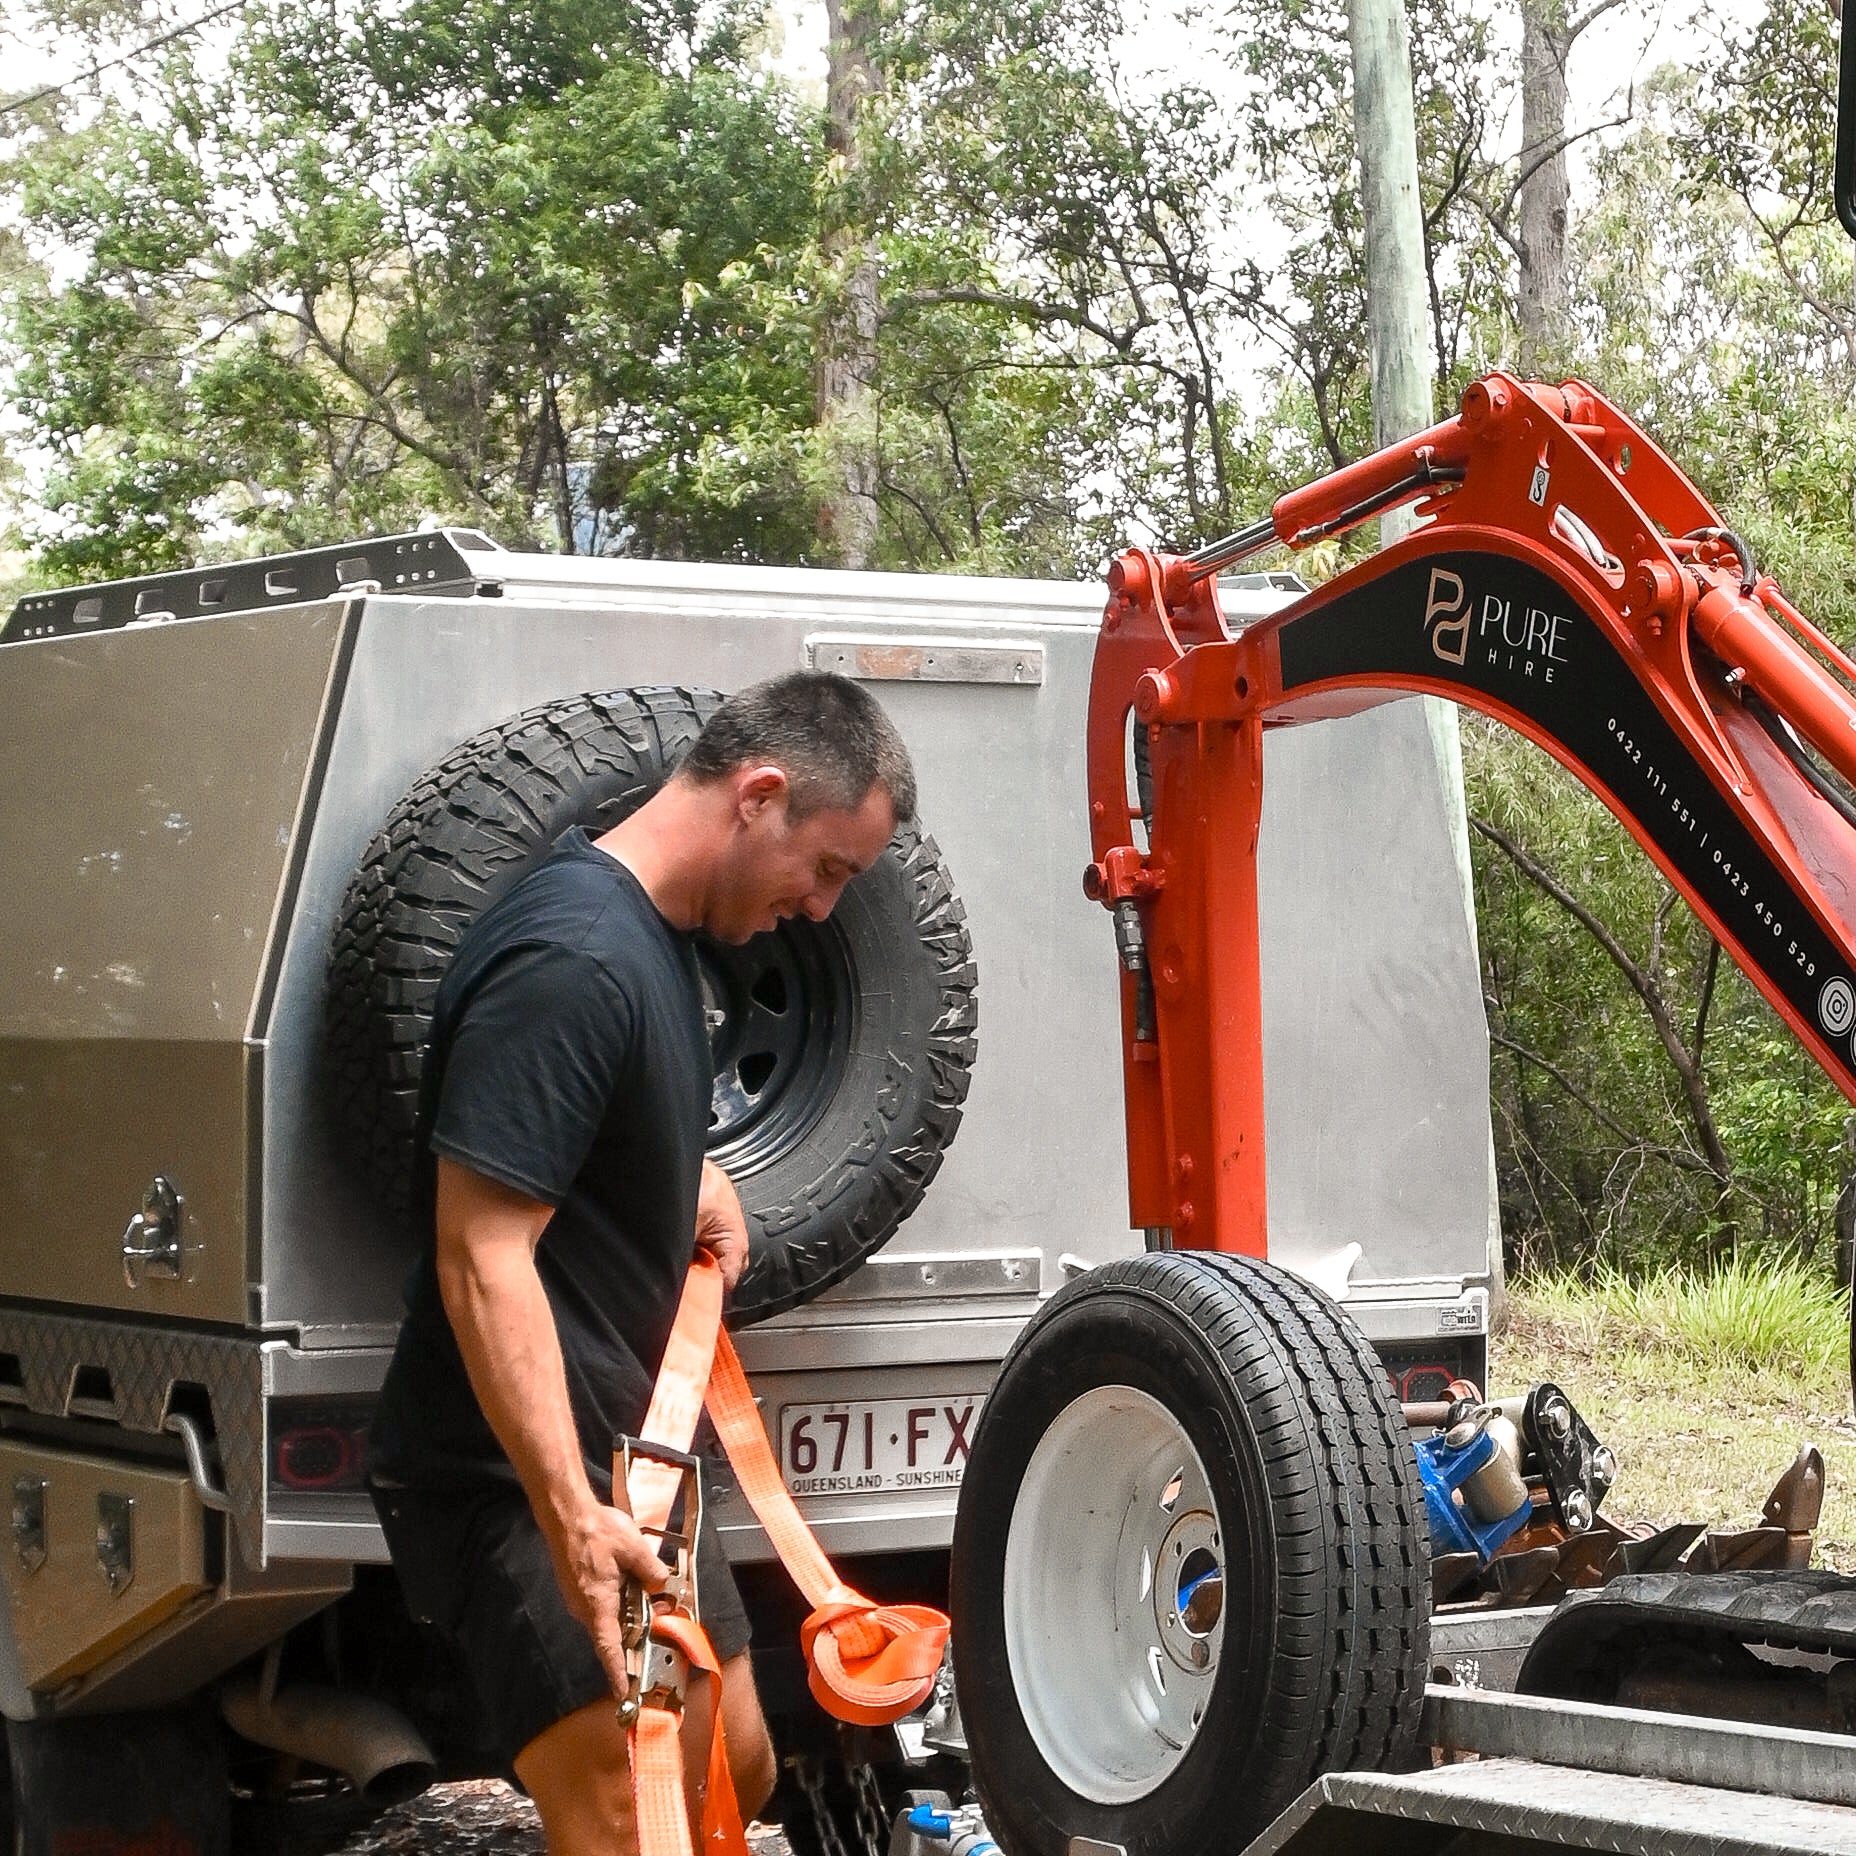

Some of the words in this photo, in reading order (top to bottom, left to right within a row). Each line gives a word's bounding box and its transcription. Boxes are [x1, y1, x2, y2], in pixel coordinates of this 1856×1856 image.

[1480, 595, 1573, 662] PURE
[1488, 648, 1555, 683] HIRE
[1607, 718, 1642, 764] 0422
[1646, 766, 1668, 796] 111
[1671, 798, 1696, 832] 551
[1713, 850, 1750, 897] 0423
[1754, 901, 1782, 936] 450
[1788, 941, 1816, 977] 529
[792, 1474, 882, 1493] QUEENSLAND
[897, 1468, 963, 1486] SUNSHINE
